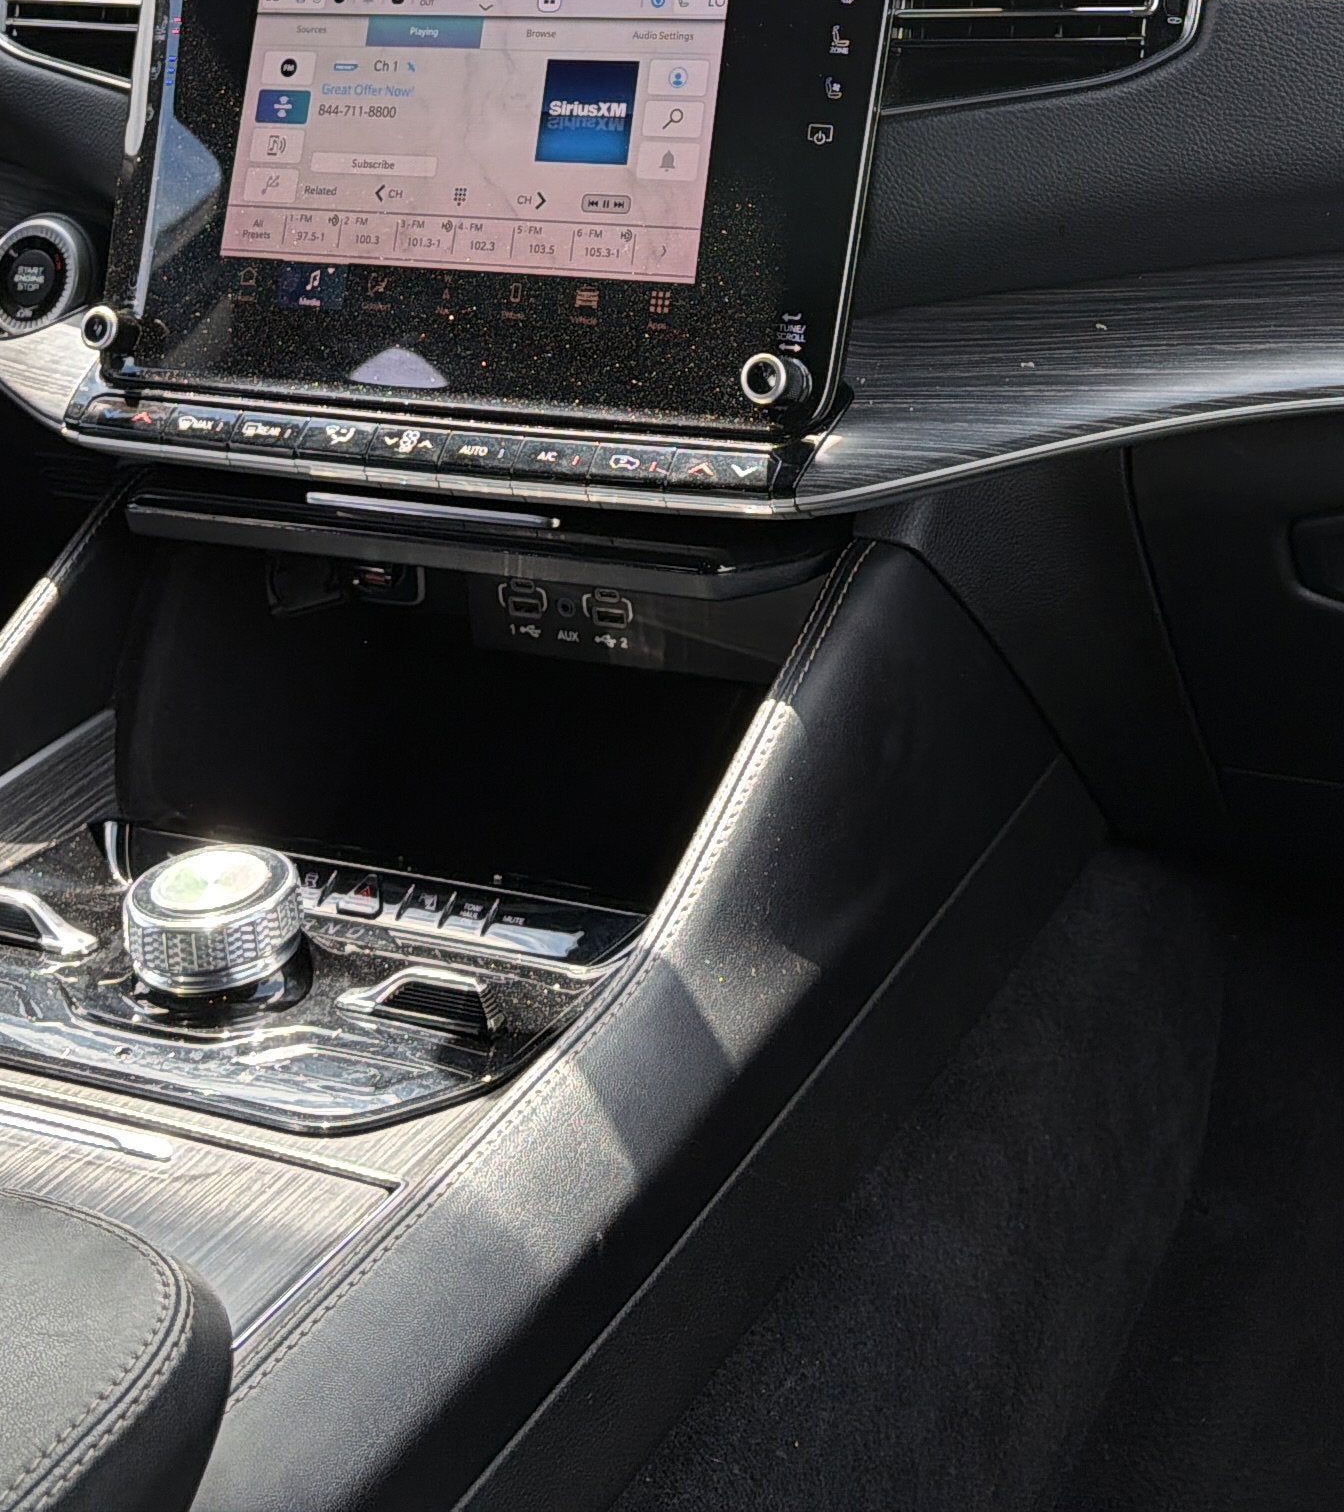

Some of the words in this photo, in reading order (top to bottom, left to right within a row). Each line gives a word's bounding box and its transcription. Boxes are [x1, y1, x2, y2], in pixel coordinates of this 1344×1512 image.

[296, 25, 326, 34] Sources
[409, 26, 439, 38] Playing
[526, 29, 556, 39] Browse
[632, 31, 657, 40] Audio
[659, 31, 694, 42] Settings
[374, 59, 389, 72] Ch
[322, 83, 353, 95] Great
[354, 84, 383, 97] Offer
[318, 104, 397, 119] 844-711-8800
[548, 100, 627, 118] SiriusXM
[351, 158, 395, 170] Subscribe
[304, 185, 337, 197] Related
[388, 189, 403, 199] CH
[517, 195, 532, 206] CH
[355, 234, 380, 245] 100.3
[469, 240, 495, 252] 102.3
[528, 243, 555, 255] 103.5
[776, 332, 806, 343] SCROLL
[459, 444, 489, 457] AUTO
[556, 629, 580, 643] AUX
[502, 915, 526, 925] MUTE
